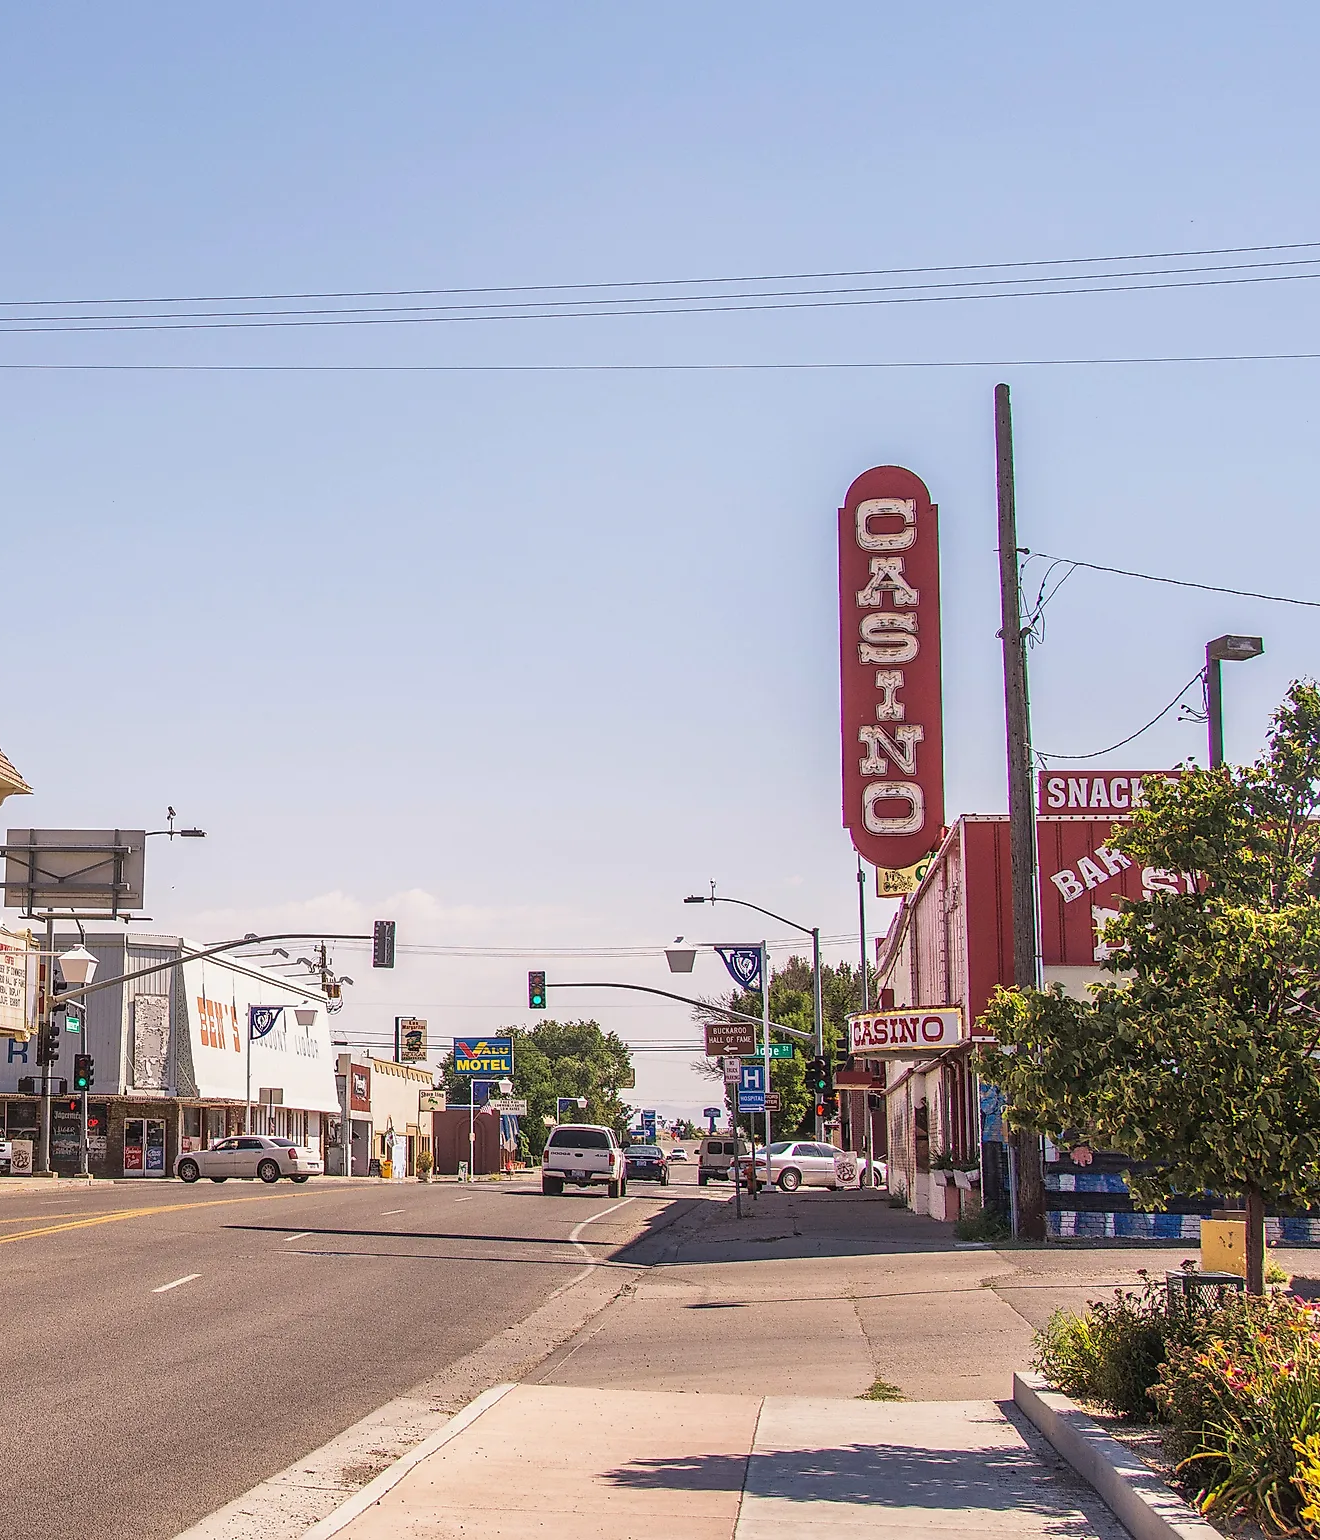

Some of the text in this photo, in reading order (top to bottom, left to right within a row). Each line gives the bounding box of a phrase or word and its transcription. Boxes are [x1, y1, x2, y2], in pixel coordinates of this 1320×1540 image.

[855, 498, 925, 837] CASINO
[1047, 777, 1151, 808] SNACK
[196, 996, 241, 1053] BEN'S
[713, 1027, 747, 1035] BUCKAROO
[853, 1016, 944, 1047] CASINO
[457, 1042, 509, 1059] VALU
[756, 1046, 780, 1057] idge
[456, 1059, 510, 1071] MOTEL
[743, 1069, 760, 1088] H
